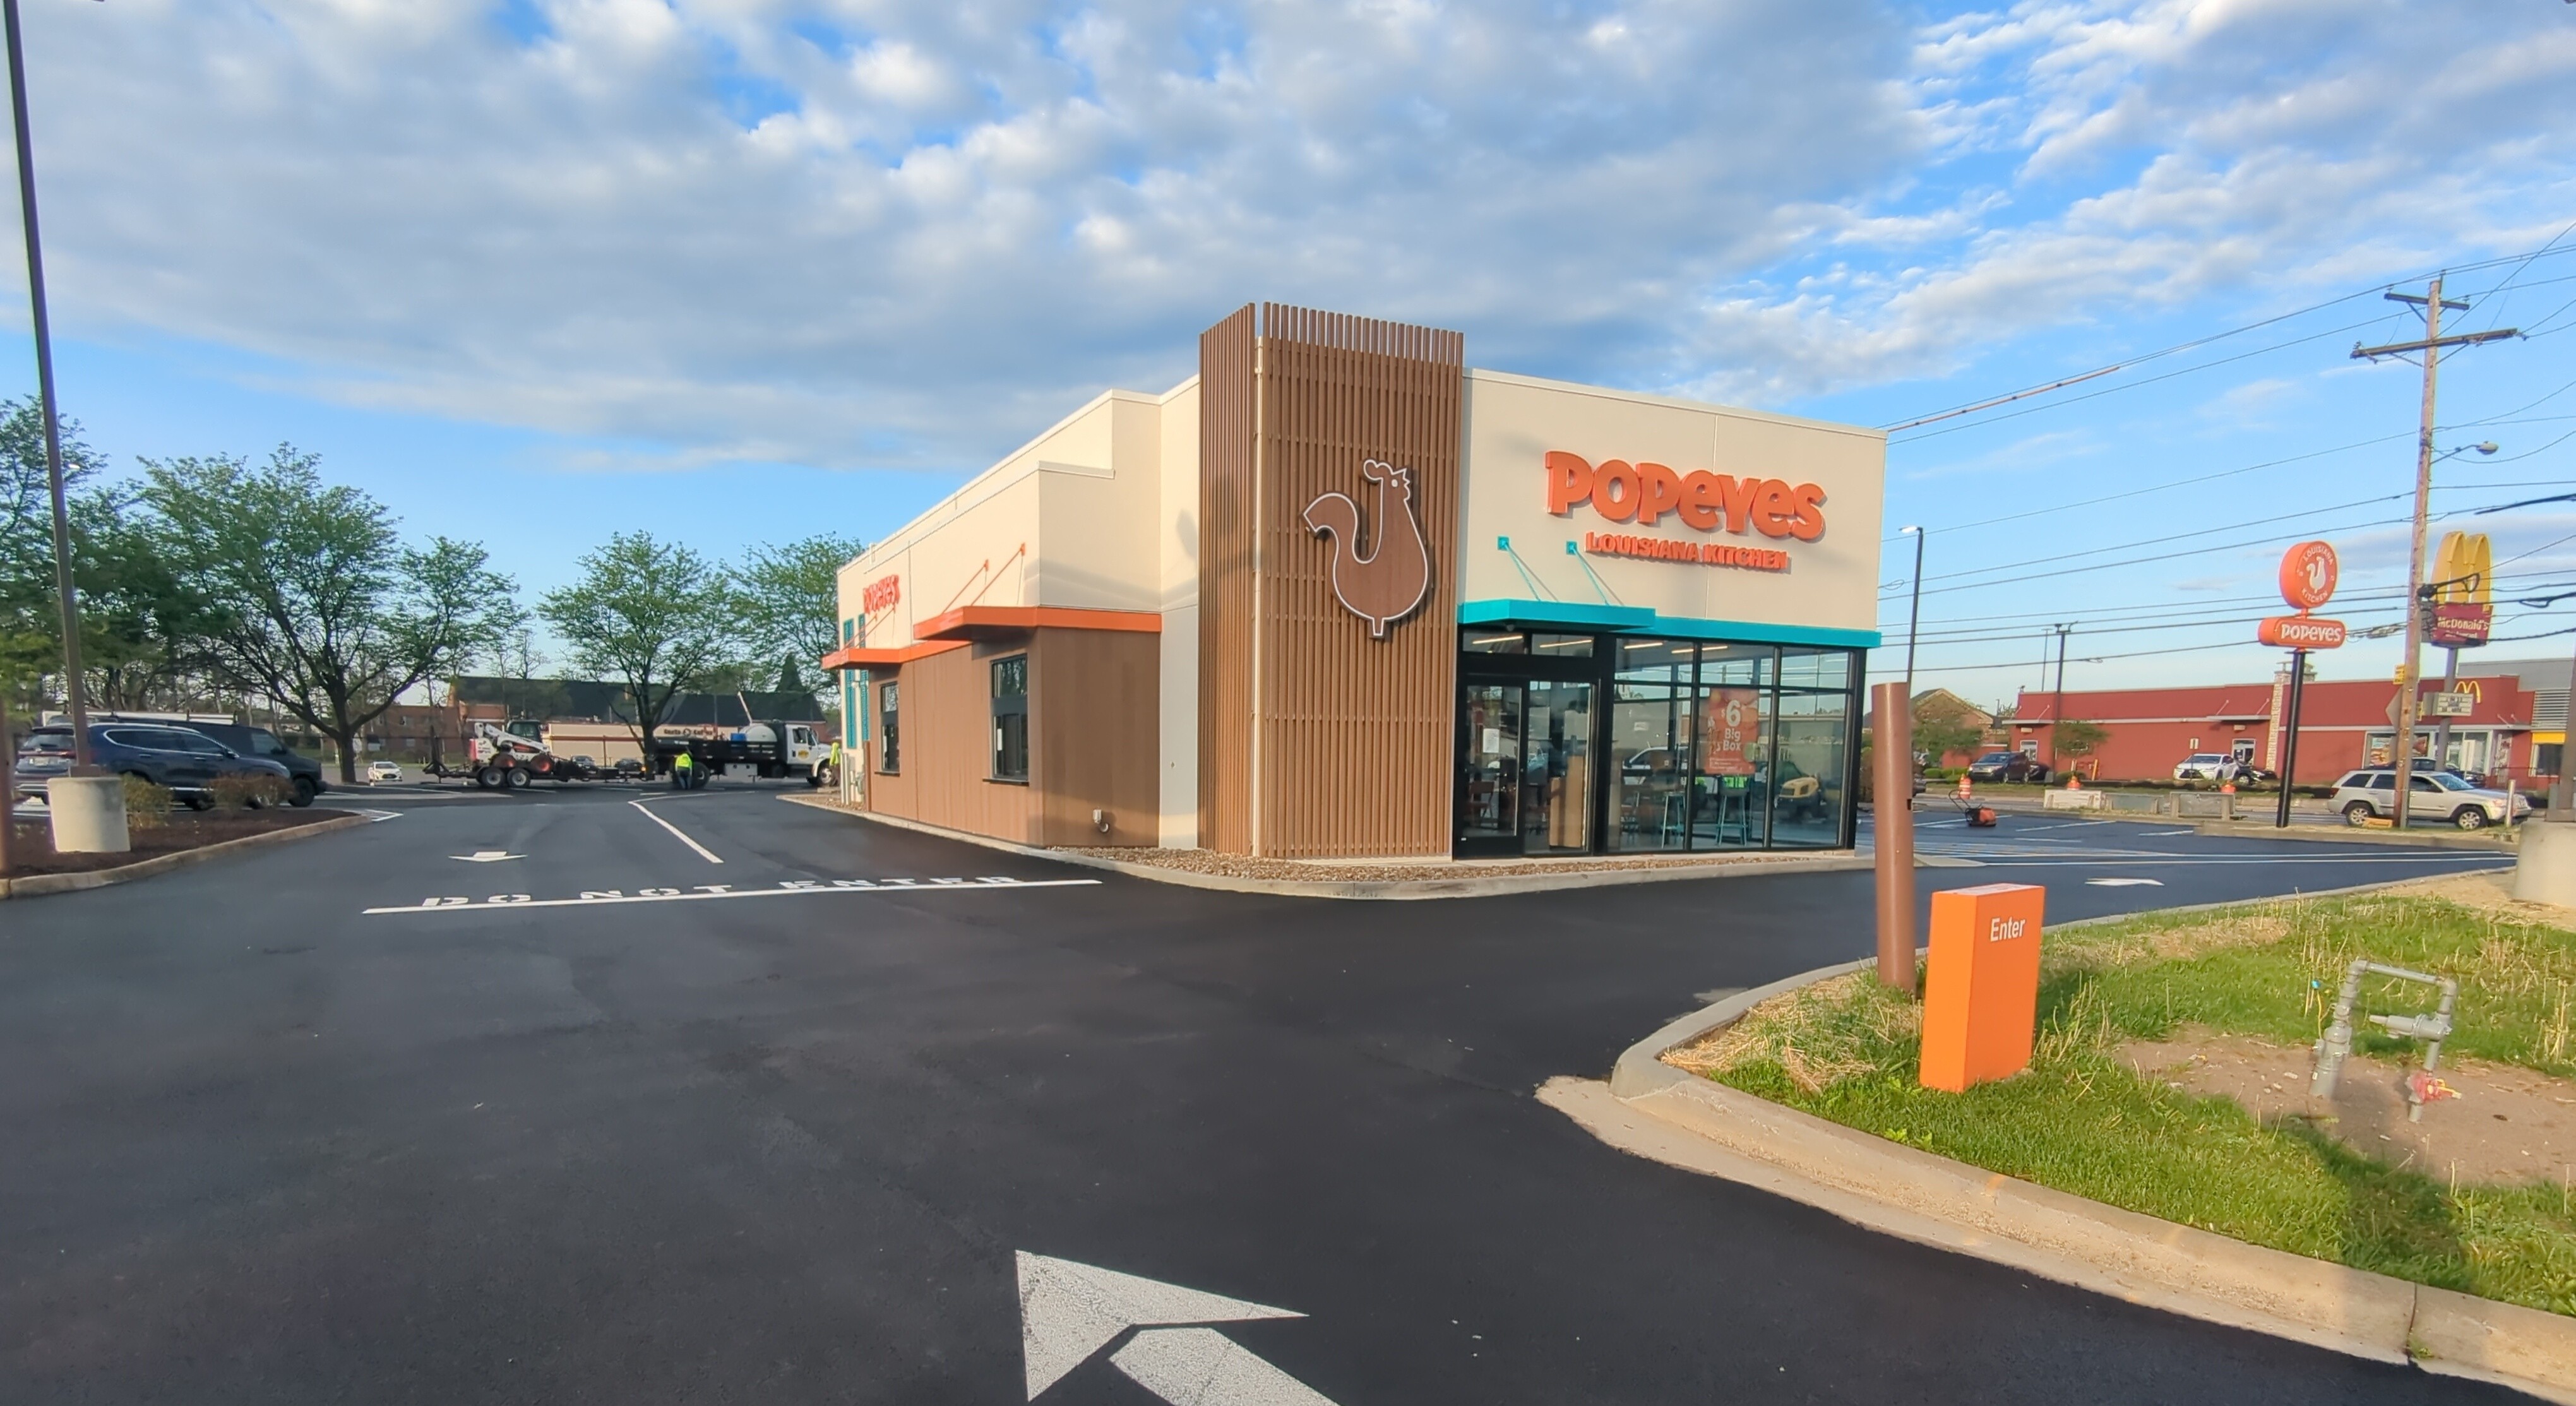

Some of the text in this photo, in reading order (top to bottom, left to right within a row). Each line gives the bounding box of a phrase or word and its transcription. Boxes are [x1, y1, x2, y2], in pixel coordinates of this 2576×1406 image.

[1585, 532, 1787, 569] LOUISIANA KITCHEN
[2303, 545, 2334, 565] LOUISIANA
[2301, 588, 2329, 603] KITCHEN
[1725, 728, 1741, 742] Big
[1723, 740, 1741, 751] Box
[422, 876, 1024, 907] DO NOT ENTER
[1990, 916, 2025, 942] Enter
